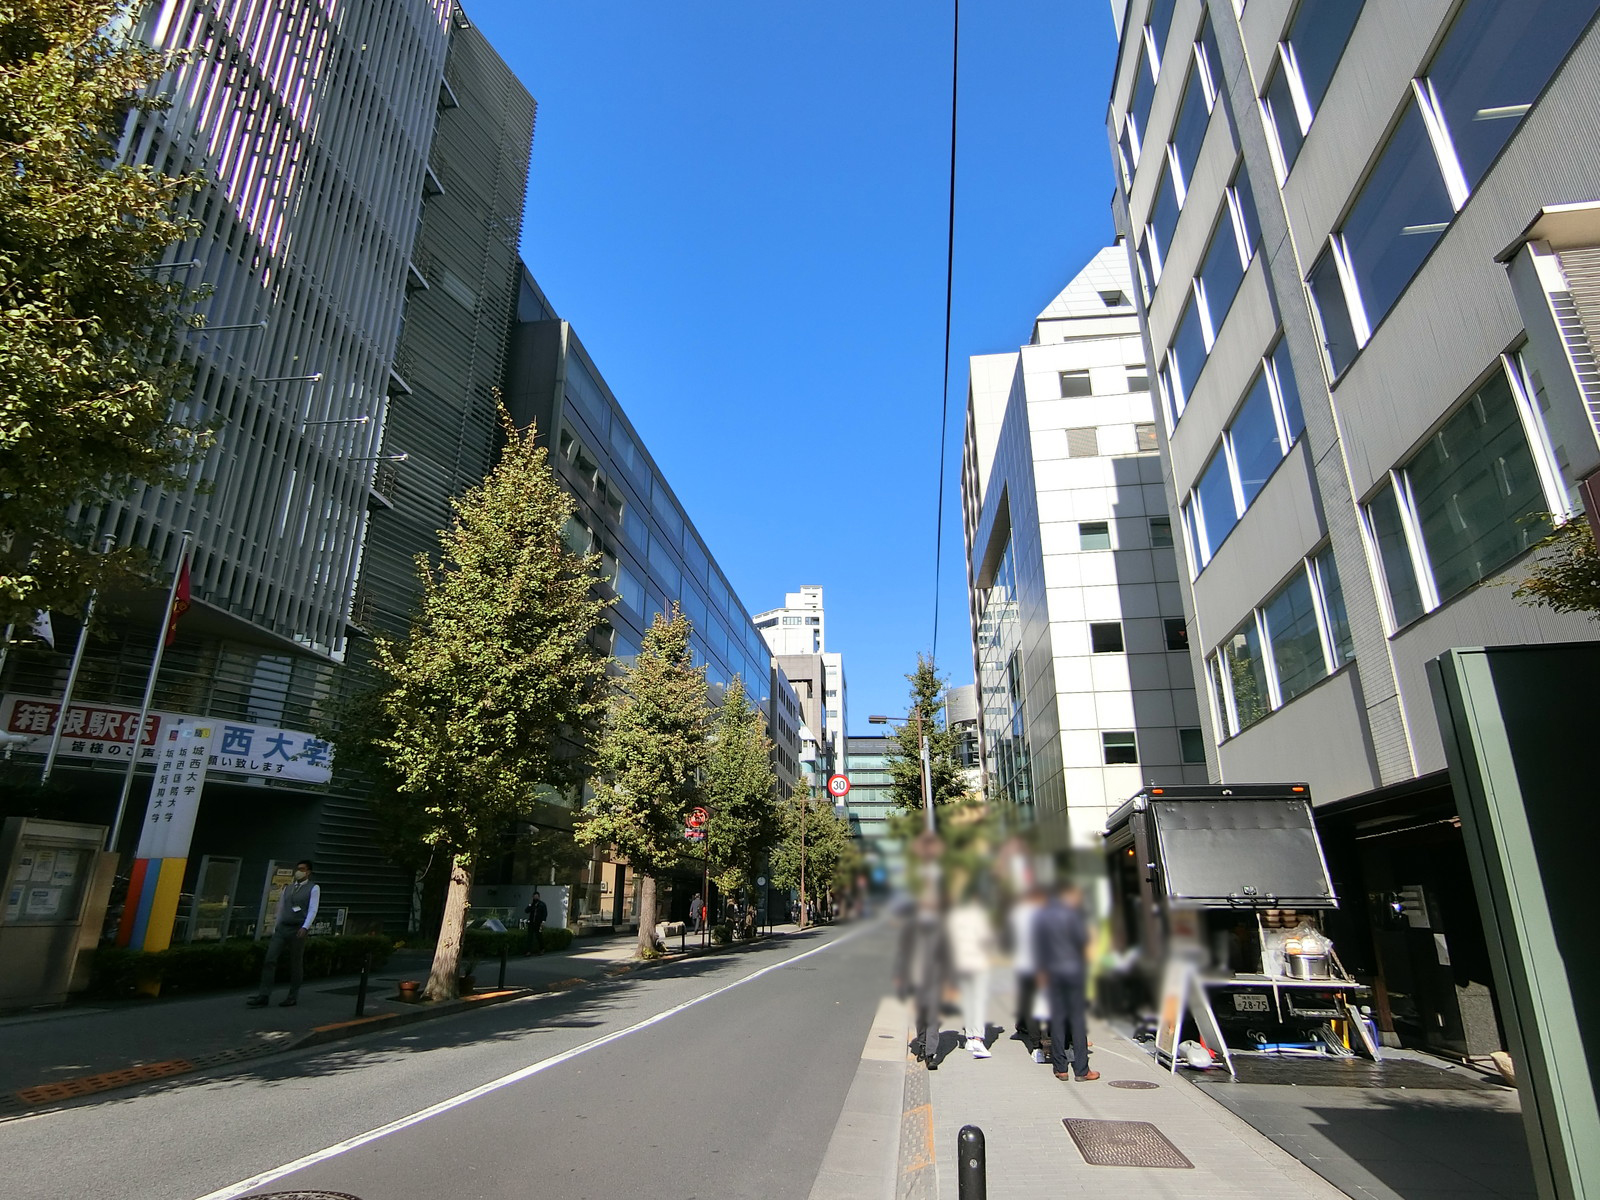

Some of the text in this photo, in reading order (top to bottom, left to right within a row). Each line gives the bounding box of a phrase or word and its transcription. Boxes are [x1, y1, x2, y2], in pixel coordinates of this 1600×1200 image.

[14, 703, 329, 765] 箱根駅伝 西大学
[184, 745, 204, 795] 城西大学
[833, 780, 845, 790] 30
